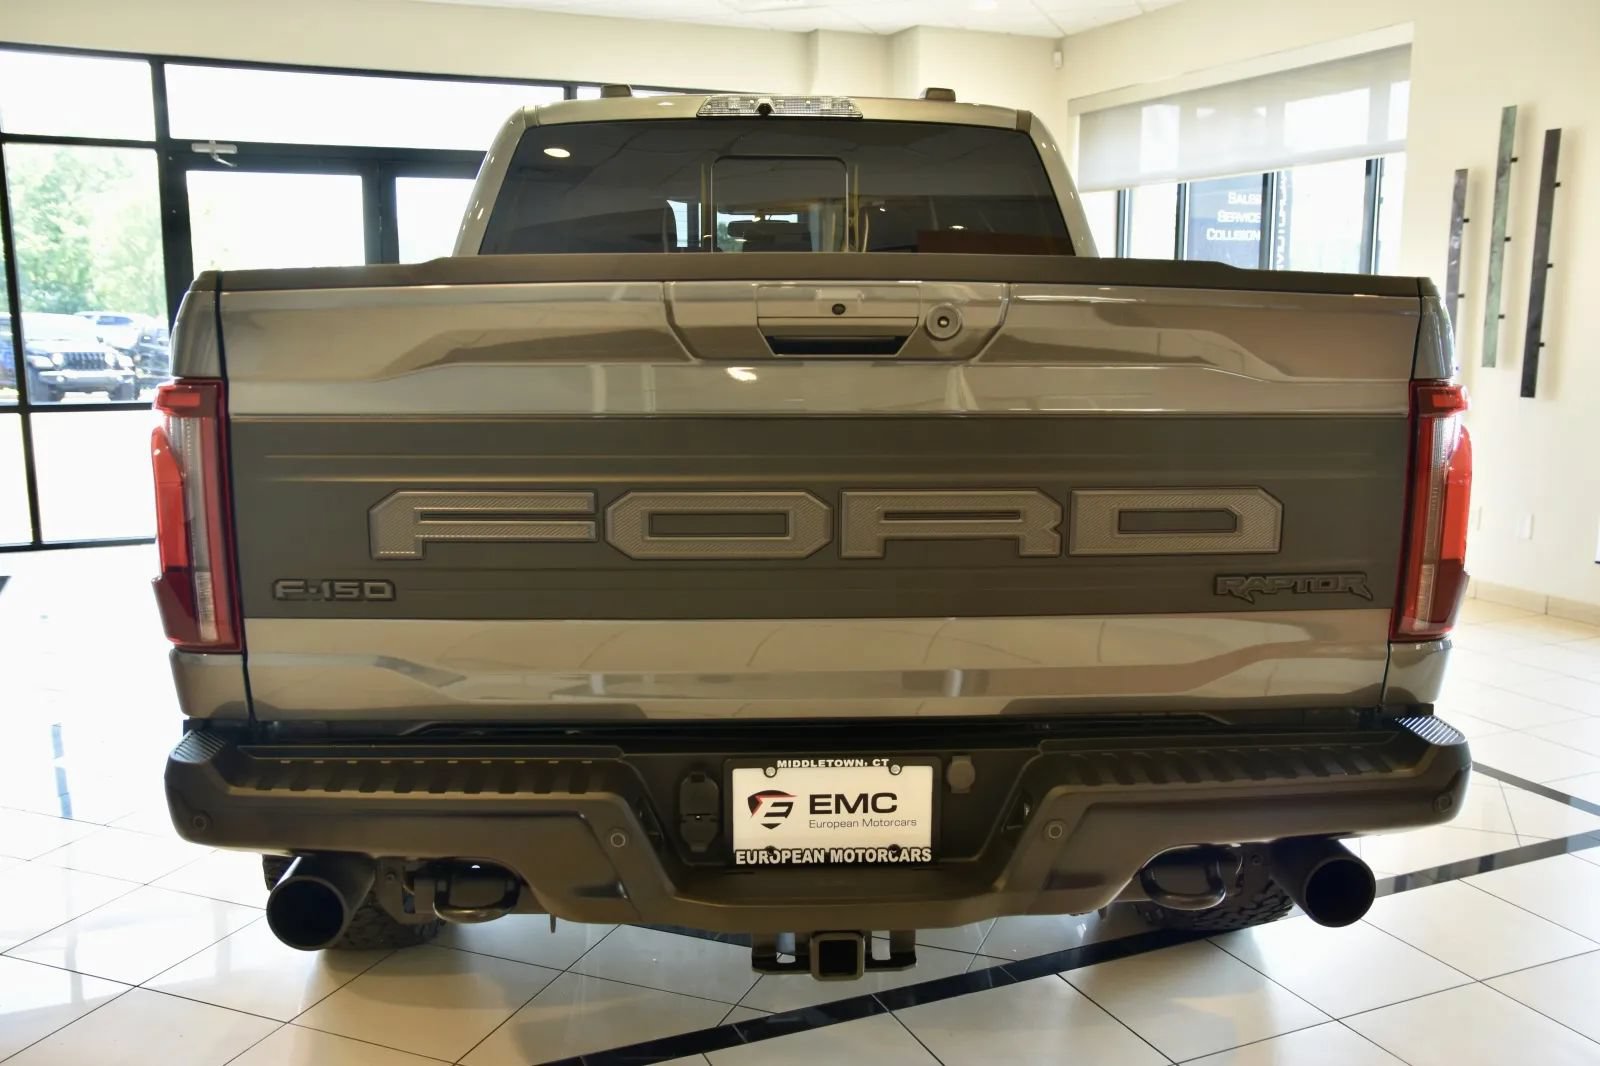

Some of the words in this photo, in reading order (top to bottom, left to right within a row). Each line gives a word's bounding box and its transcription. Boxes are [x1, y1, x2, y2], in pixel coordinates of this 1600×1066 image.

[368, 488, 1282, 560] FORD
[273, 579, 399, 601] F-150
[1214, 571, 1374, 604] RAPTOR
[872, 758, 890, 768] CT
[809, 792, 898, 814] EMC
[809, 819, 859, 830] European
[862, 817, 918, 829] Motorcars
[735, 848, 825, 865] EUROPEAN
[830, 847, 932, 864] MOTORCARS
